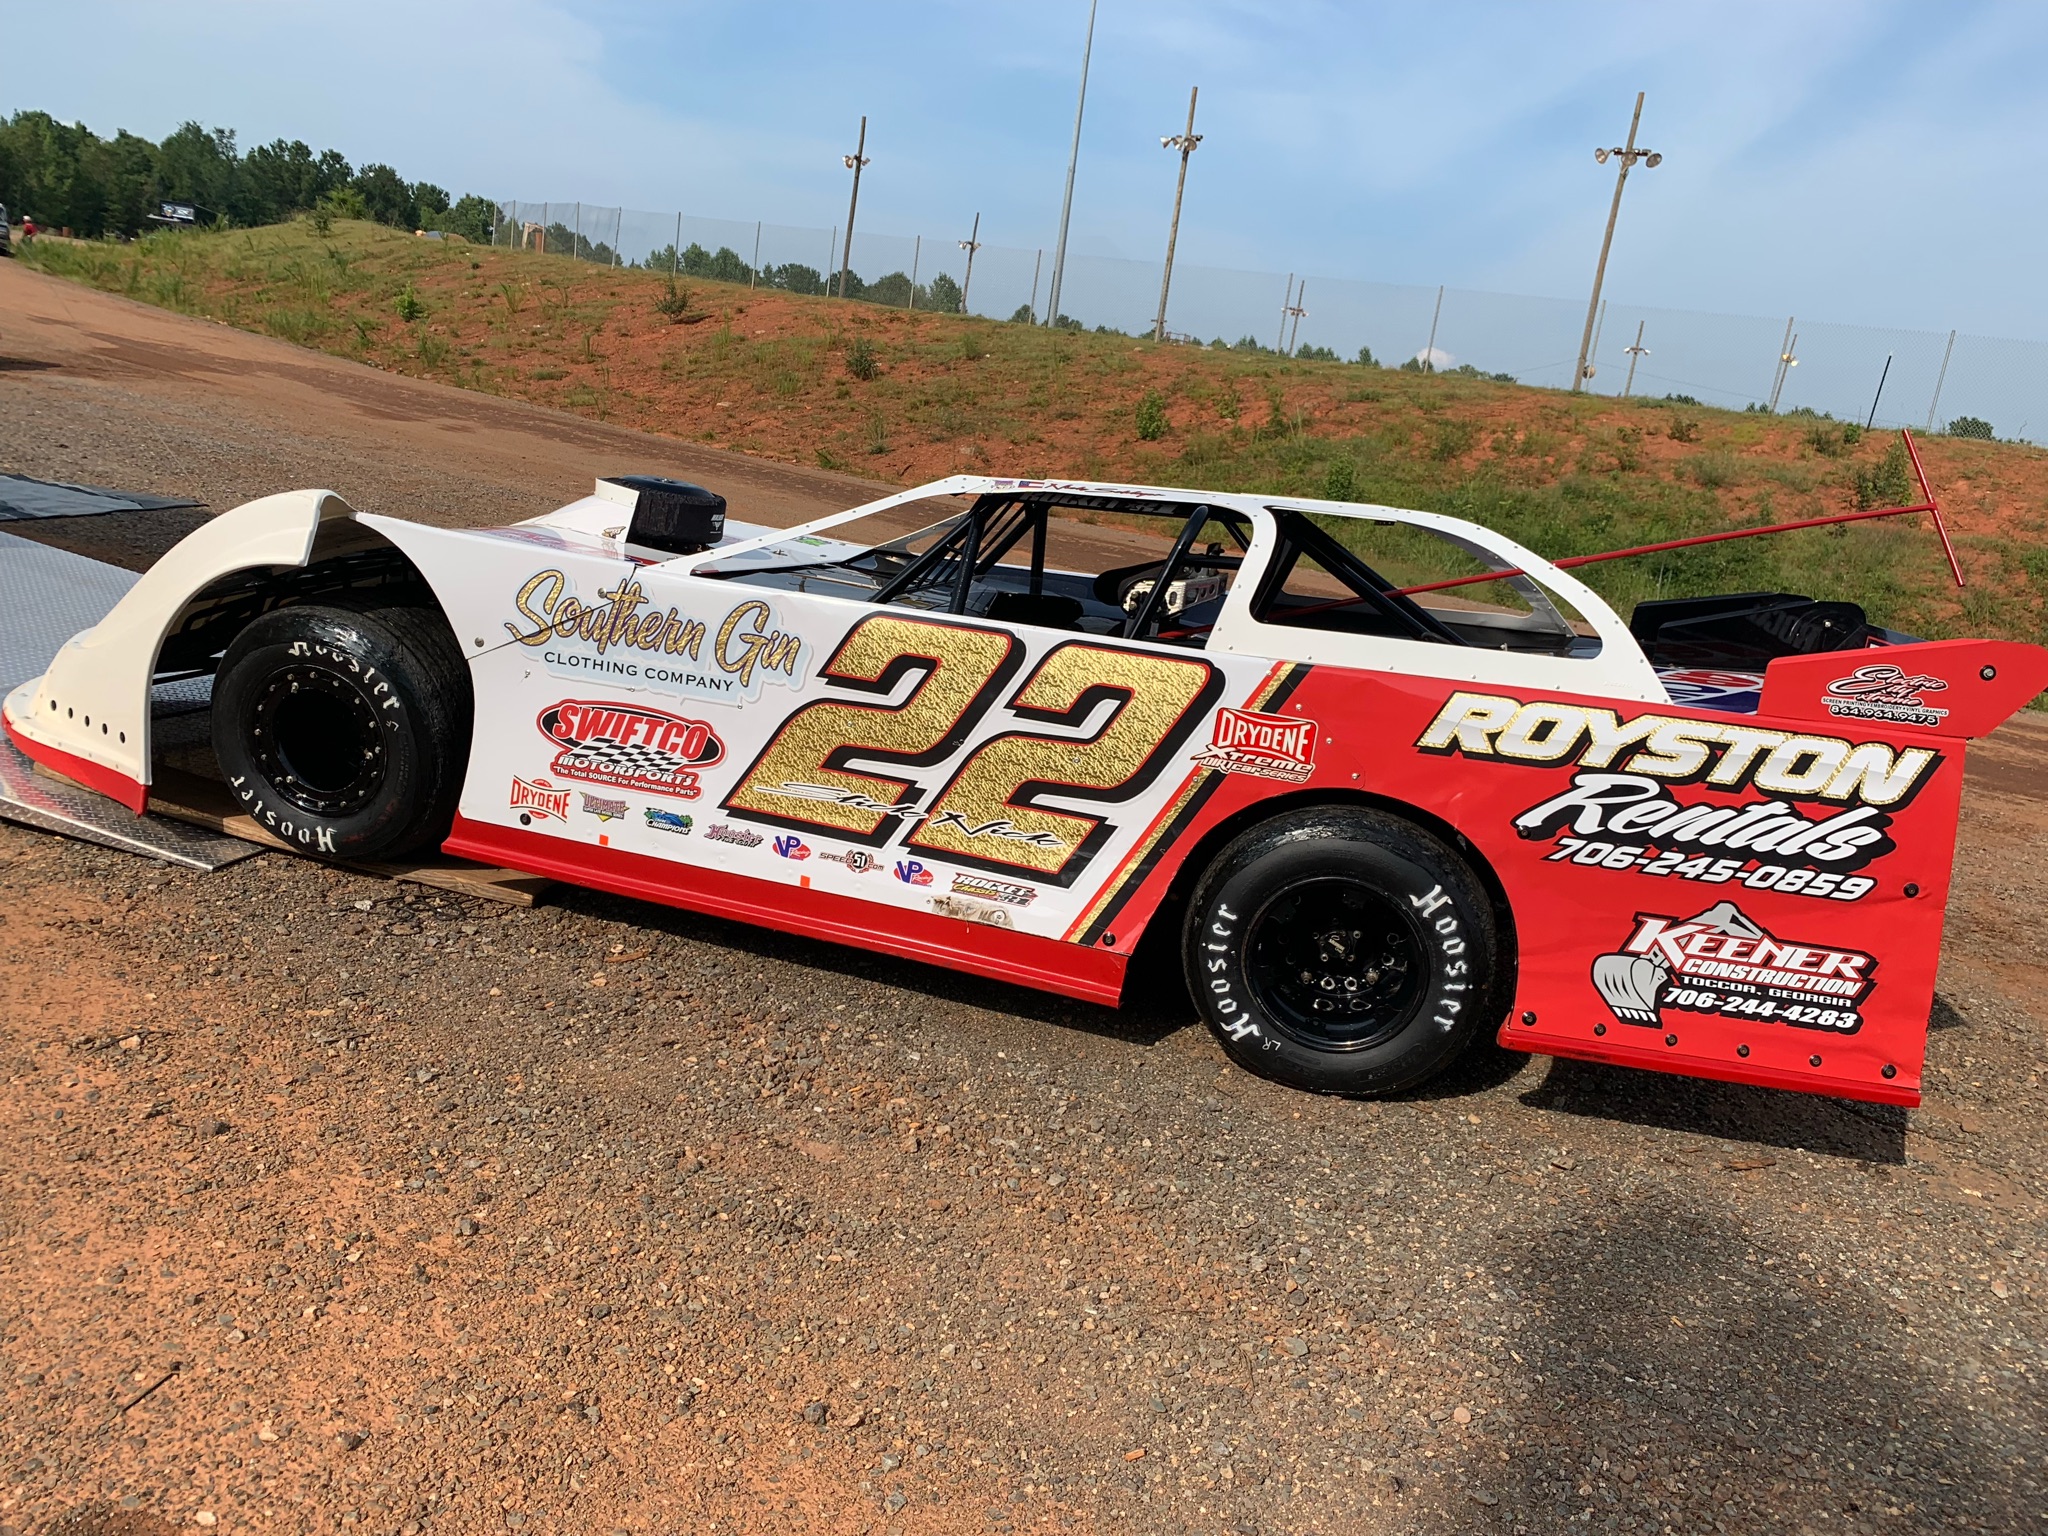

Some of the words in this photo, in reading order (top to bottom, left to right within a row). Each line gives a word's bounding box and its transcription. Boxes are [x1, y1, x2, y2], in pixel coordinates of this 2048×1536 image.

[504, 569, 706, 661] Southern
[714, 600, 802, 687] Gin
[288, 641, 401, 710] Hoosier
[544, 651, 638, 677] CLOTHING
[644, 667, 734, 692] COMPANY
[1830, 705, 1937, 724] 864.964.9475
[1869, 702, 1902, 710] EMBROIDERY
[1922, 708, 1948, 716] GRAPHICS
[552, 704, 709, 760] SWIFTCO
[722, 611, 1226, 889] 22
[1217, 709, 1312, 762] DRYDENE
[1416, 692, 1940, 806] ROYSTON
[558, 755, 695, 786] MOTORSPORTS
[570, 768, 587, 778] Total
[588, 771, 617, 783] SOURCE
[618, 777, 629, 786] For
[630, 780, 674, 793] Performance
[230, 776, 338, 853] Hoosier
[510, 778, 571, 819] DRYDENE
[1518, 773, 1882, 863] Rentals
[774, 835, 801, 858] VP
[853, 853, 866, 867] 51
[896, 860, 923, 884] VP
[955, 875, 1030, 896] ROCKET
[1549, 838, 1875, 900] 706-245-0859
[1408, 884, 1474, 1032] Hoosier
[1624, 917, 1867, 979] KEENER
[1202, 903, 1263, 1042] Hoosier
[1682, 959, 1863, 997] CONSTRUCTION
[1663, 988, 1858, 1029] 706-244-4283
[1769, 988, 1852, 1007] GEORGIA
